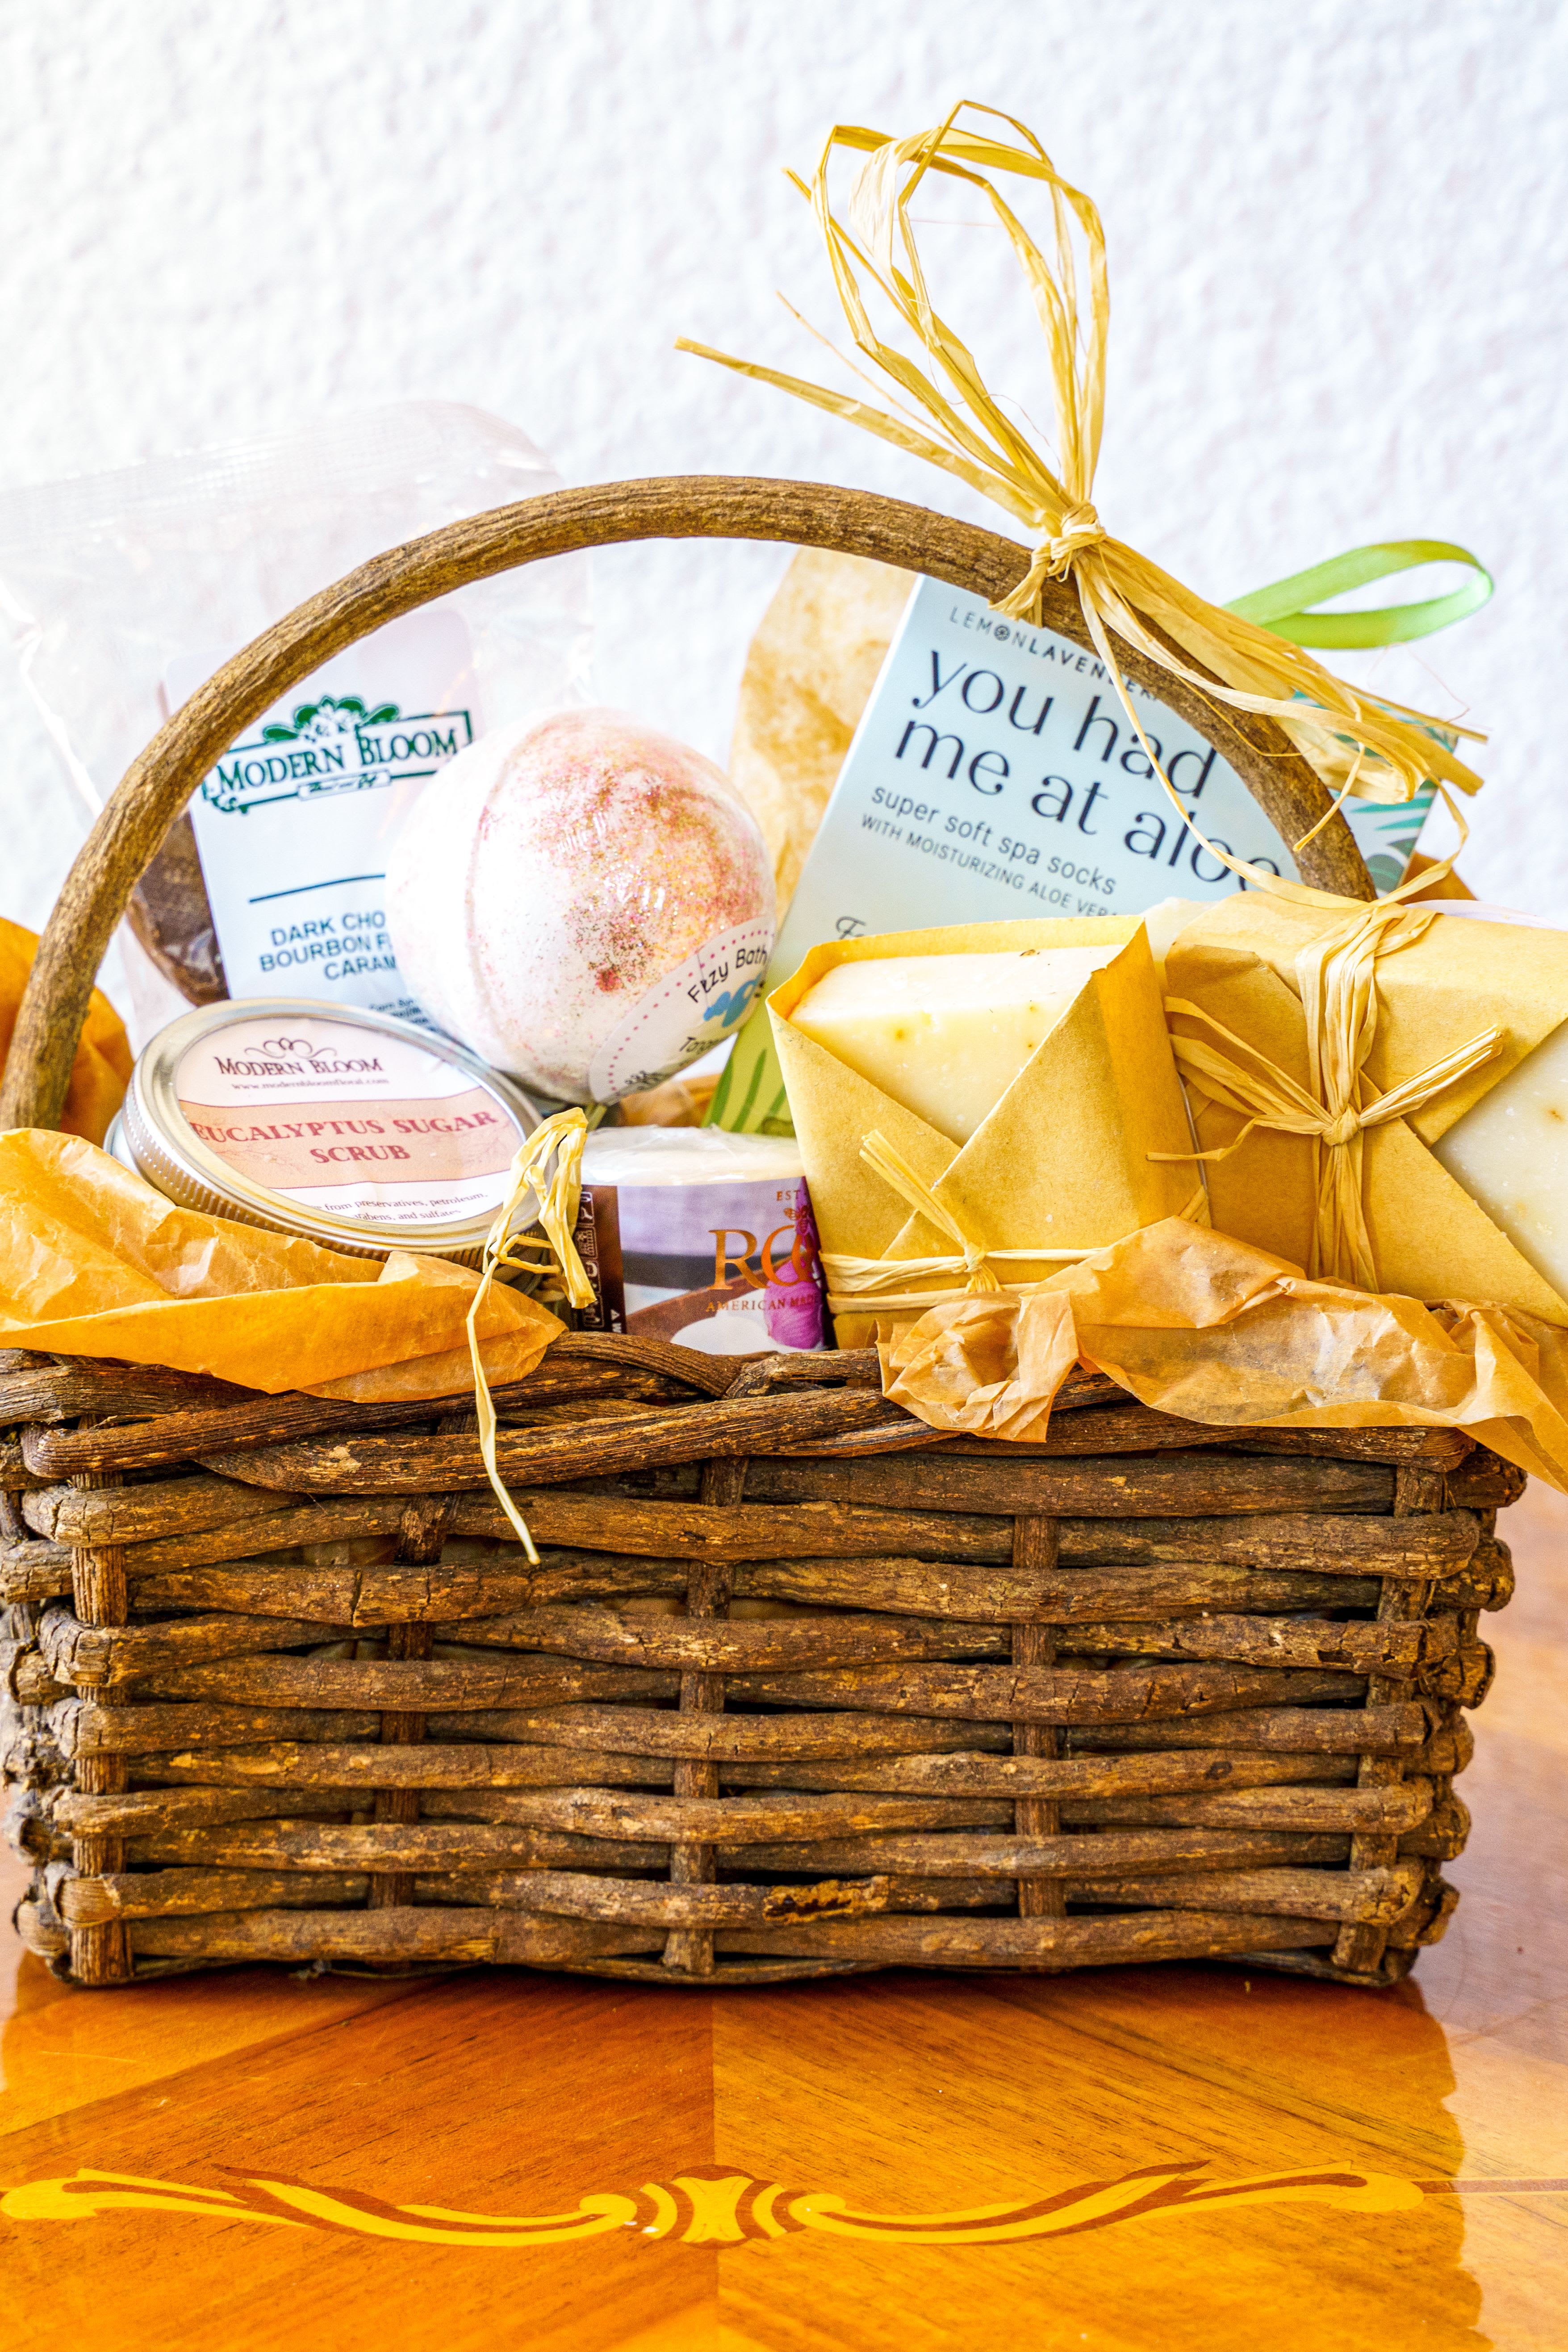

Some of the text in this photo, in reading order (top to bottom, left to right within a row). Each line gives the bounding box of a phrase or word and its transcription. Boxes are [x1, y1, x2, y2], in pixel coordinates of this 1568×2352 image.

[912, 650, 1217, 799] you had
[216, 744, 347, 793] MODERN
[356, 728, 459, 766] BLOOM
[895, 720, 1010, 795] me
[1031, 774, 1109, 835] at
[871, 787, 1116, 896] super soft spa socks
[861, 813, 1117, 916] WITH MOISTURIZING ALOE VER
[270, 910, 386, 947] DARK CHO
[258, 934, 372, 973] BOURBON
[323, 955, 397, 981] CARAM
[214, 1056, 385, 1076] MODERN BLOOM
[189, 1111, 499, 1143] EUCALYPTUS SUGAR
[310, 1144, 410, 1164] SCRUB
[324, 1202, 352, 1211] from
[354, 1199, 428, 1209] preservatives,
[398, 1210, 418, 1220] and
[705, 1297, 786, 1313] AMERICAN
